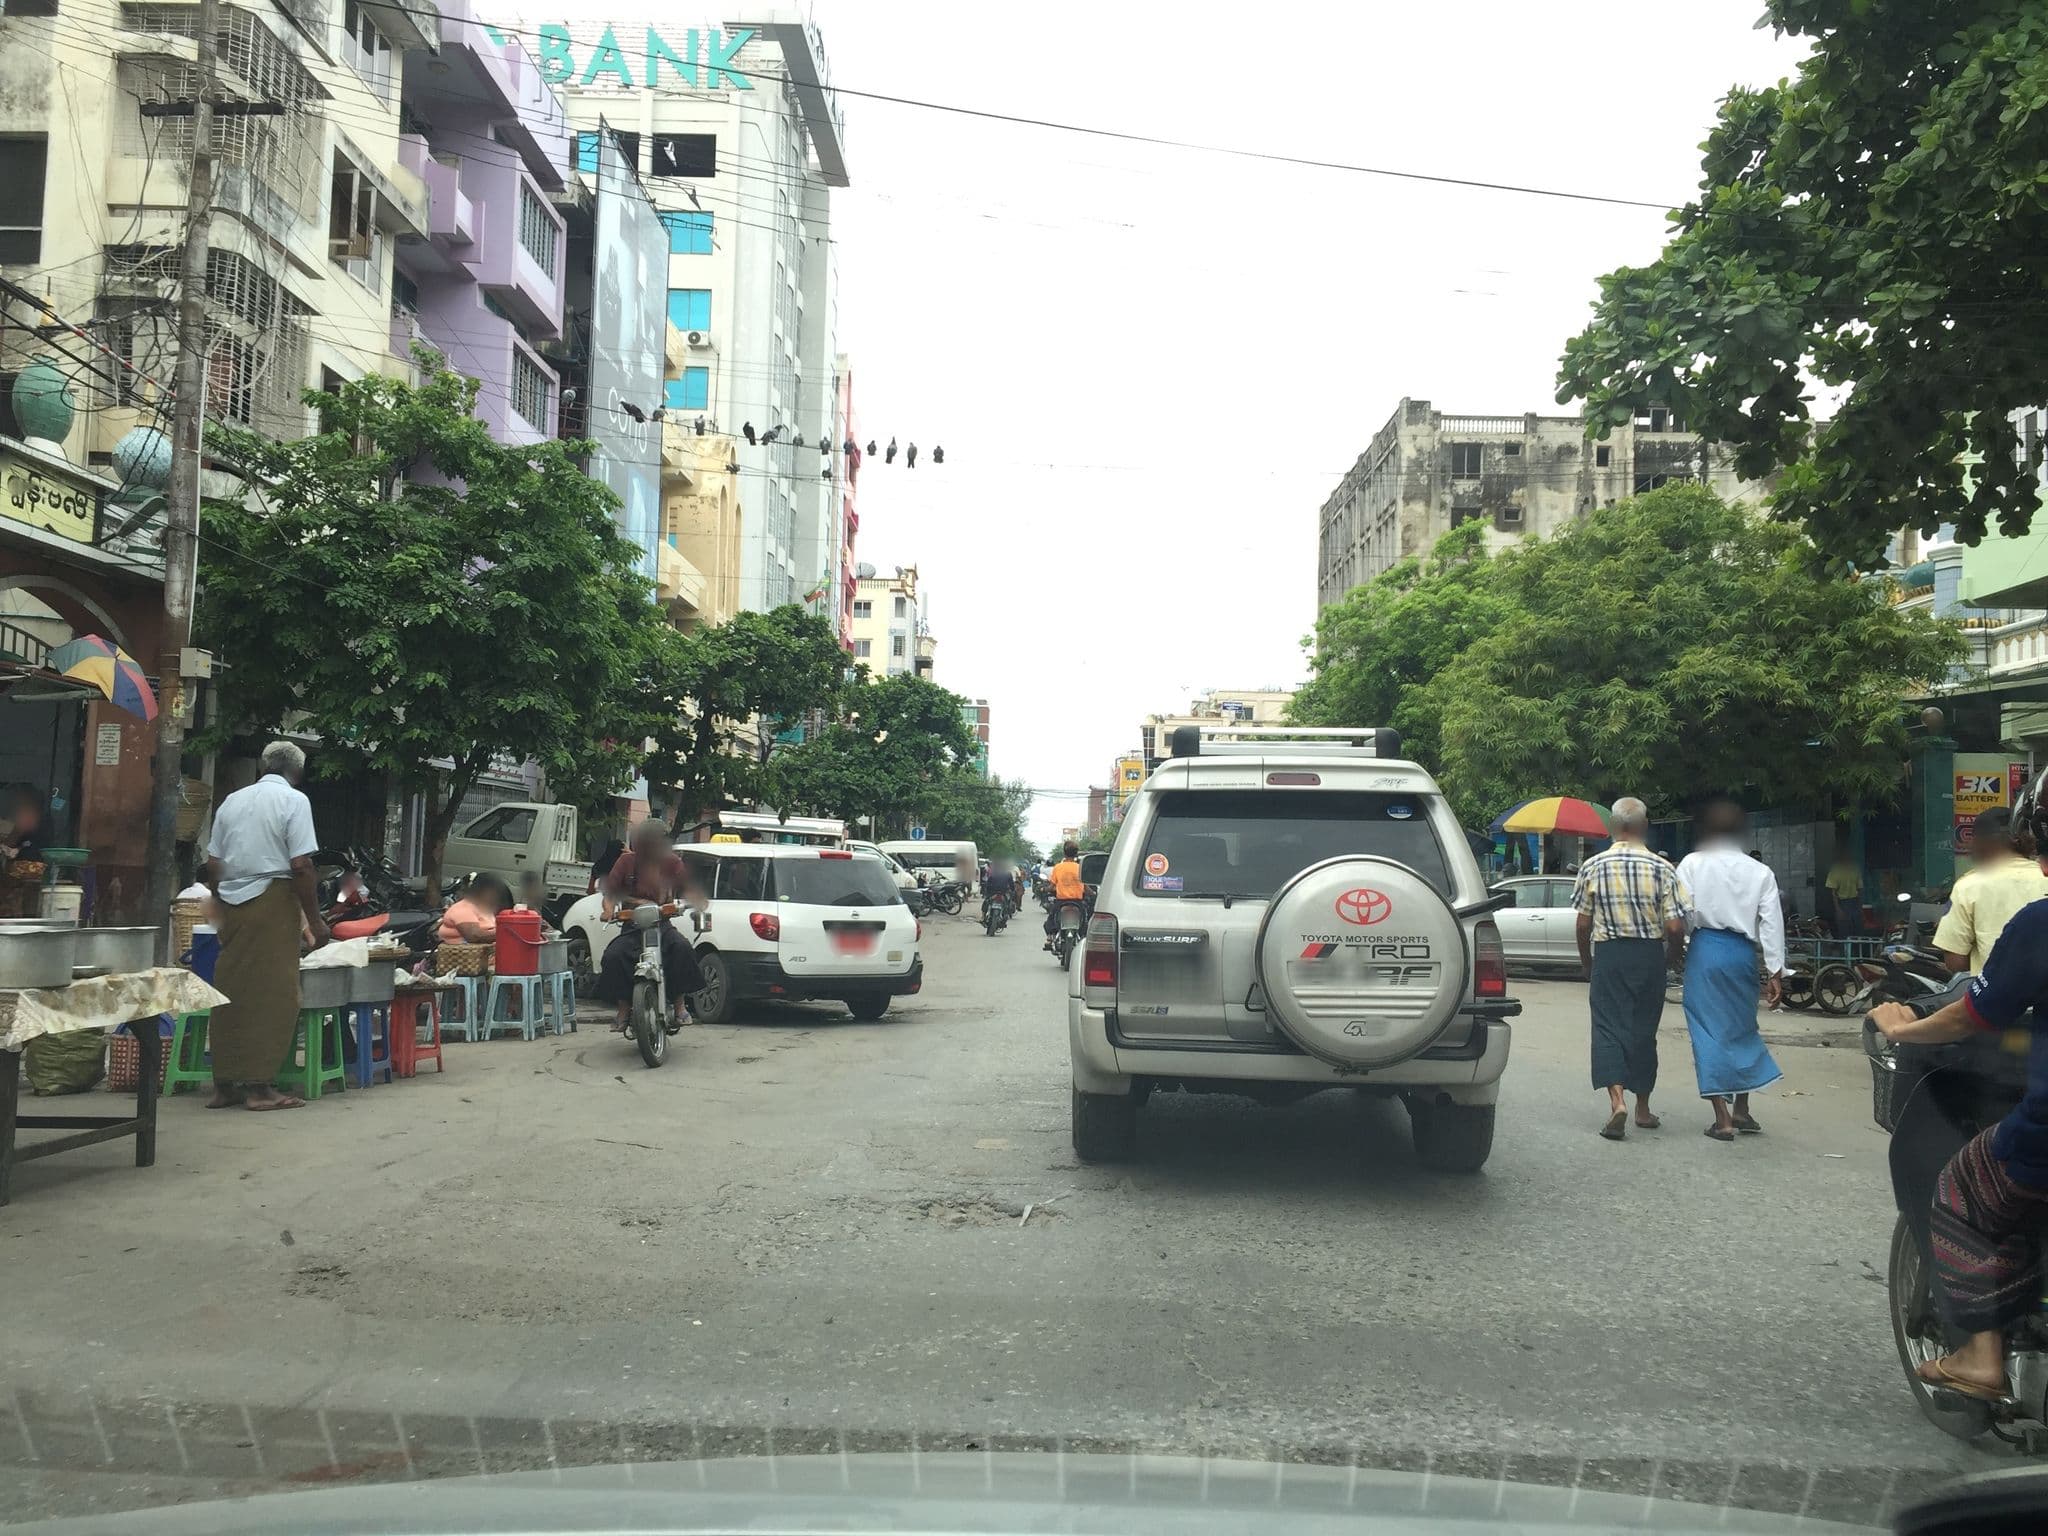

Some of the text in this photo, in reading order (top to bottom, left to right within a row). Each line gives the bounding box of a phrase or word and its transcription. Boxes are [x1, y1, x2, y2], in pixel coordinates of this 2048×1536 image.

[537, 23, 757, 90] BANK
[1960, 775, 1998, 794] 3K
[1956, 794, 2000, 802] BATTERY
[1161, 935, 1199, 944] SURF
[1301, 934, 1429, 944] TOYOTA MOTOR SPORTS
[1345, 944, 1431, 959] TRD
